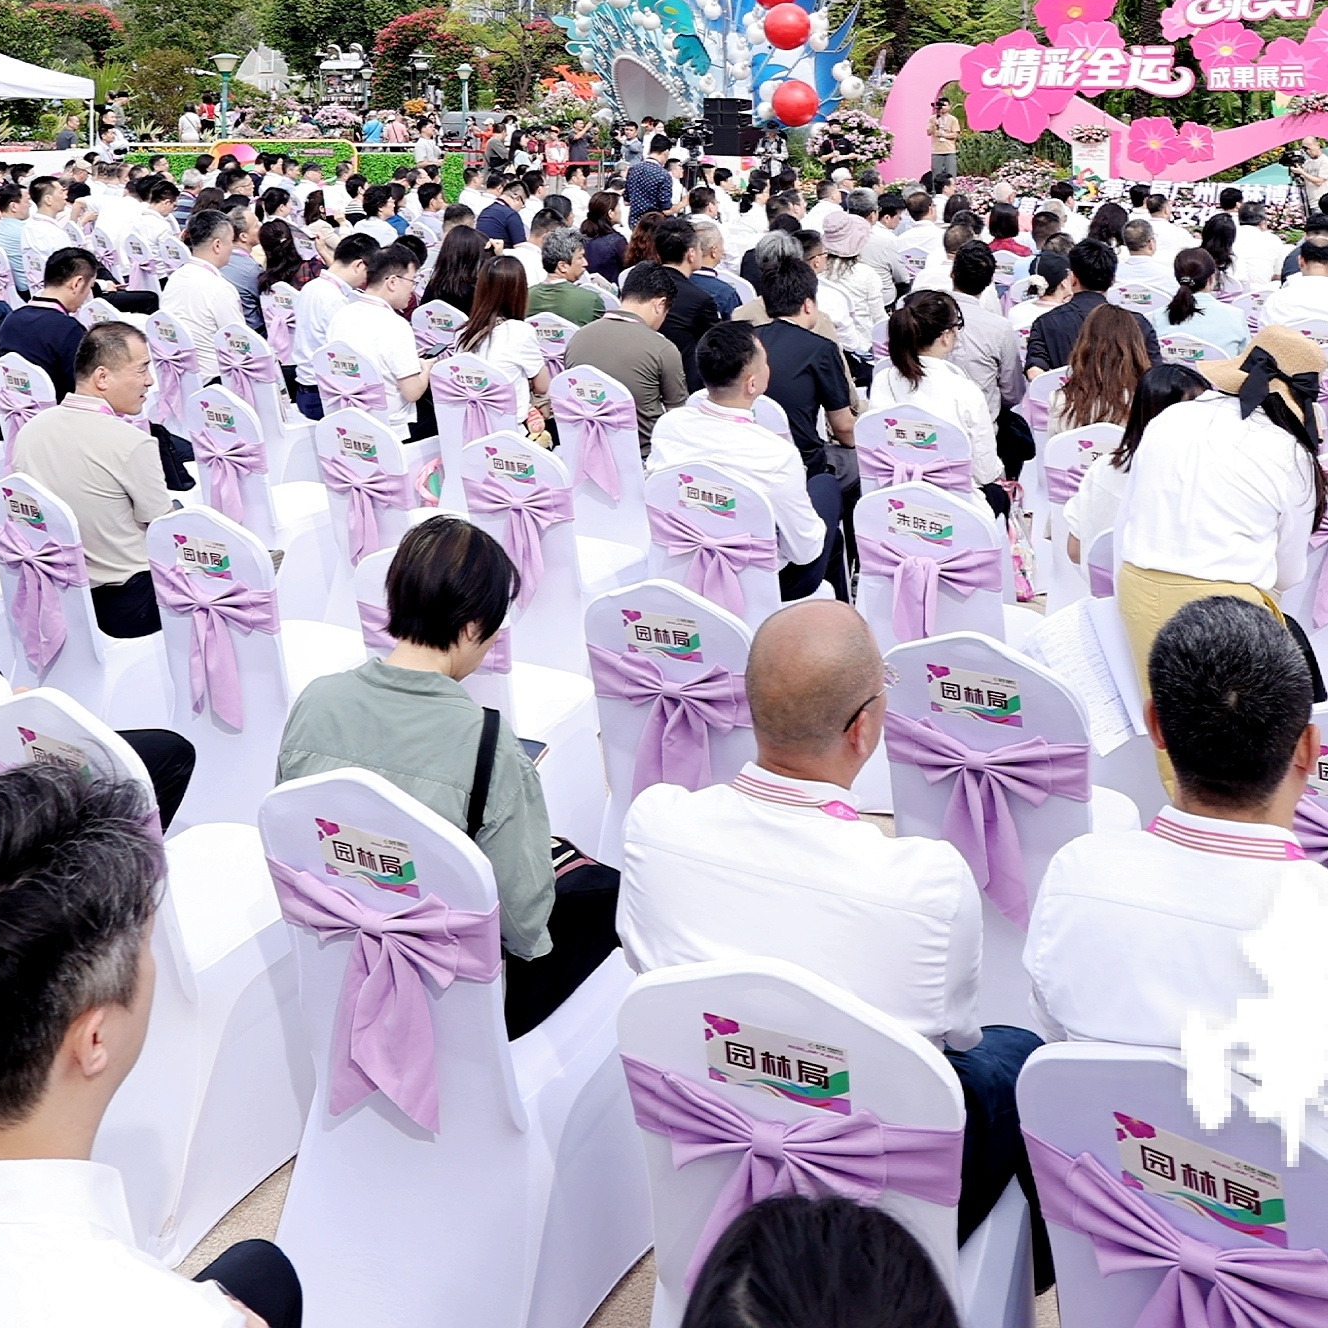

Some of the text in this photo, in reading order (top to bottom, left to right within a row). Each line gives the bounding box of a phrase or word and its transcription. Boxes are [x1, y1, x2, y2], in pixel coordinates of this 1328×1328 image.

[981, 45, 1195, 98] 精彩全运
[1209, 64, 1306, 91] 成果展示
[343, 437, 372, 455] 园林局
[493, 457, 529, 475] 园林局
[10, 498, 42, 519] 园林局
[686, 485, 728, 508] 园林局
[183, 547, 223, 568] 园林局
[635, 625, 690, 648] 园林局
[940, 682, 1008, 710] 园林局
[332, 840, 403, 877] 园林局
[725, 1041, 829, 1089] 园林局
[1140, 1144, 1262, 1216] 园林局
